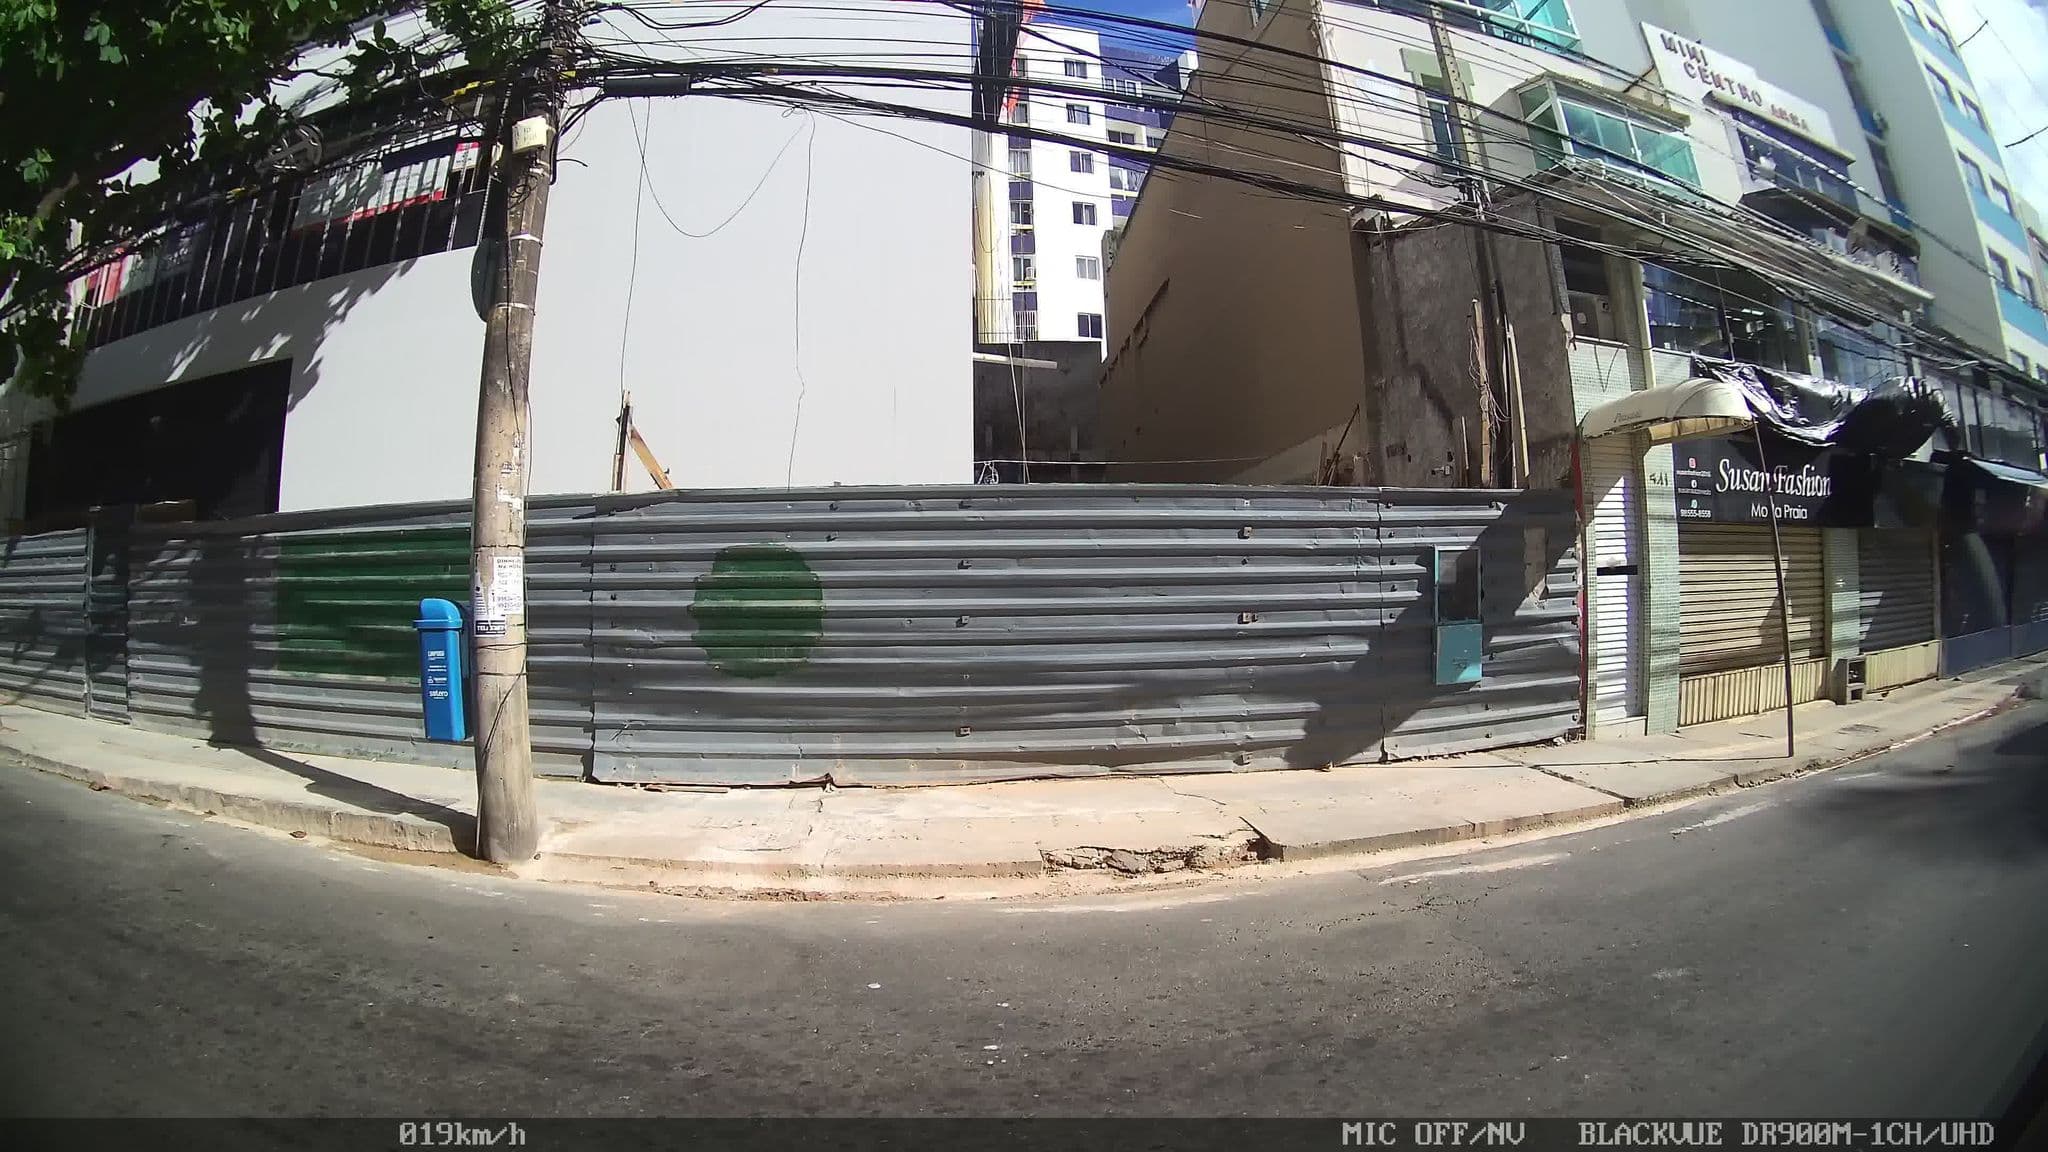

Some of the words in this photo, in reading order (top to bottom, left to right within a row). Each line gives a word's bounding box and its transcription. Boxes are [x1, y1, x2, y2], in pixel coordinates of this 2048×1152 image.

[1660, 33, 1708, 67] MINI
[1683, 61, 1762, 107] CENTRO
[1715, 458, 1772, 492] Susan
[1774, 464, 1832, 498] Fashion
[1751, 503, 1782, 518] Moa
[1784, 504, 1808, 519] Praia
